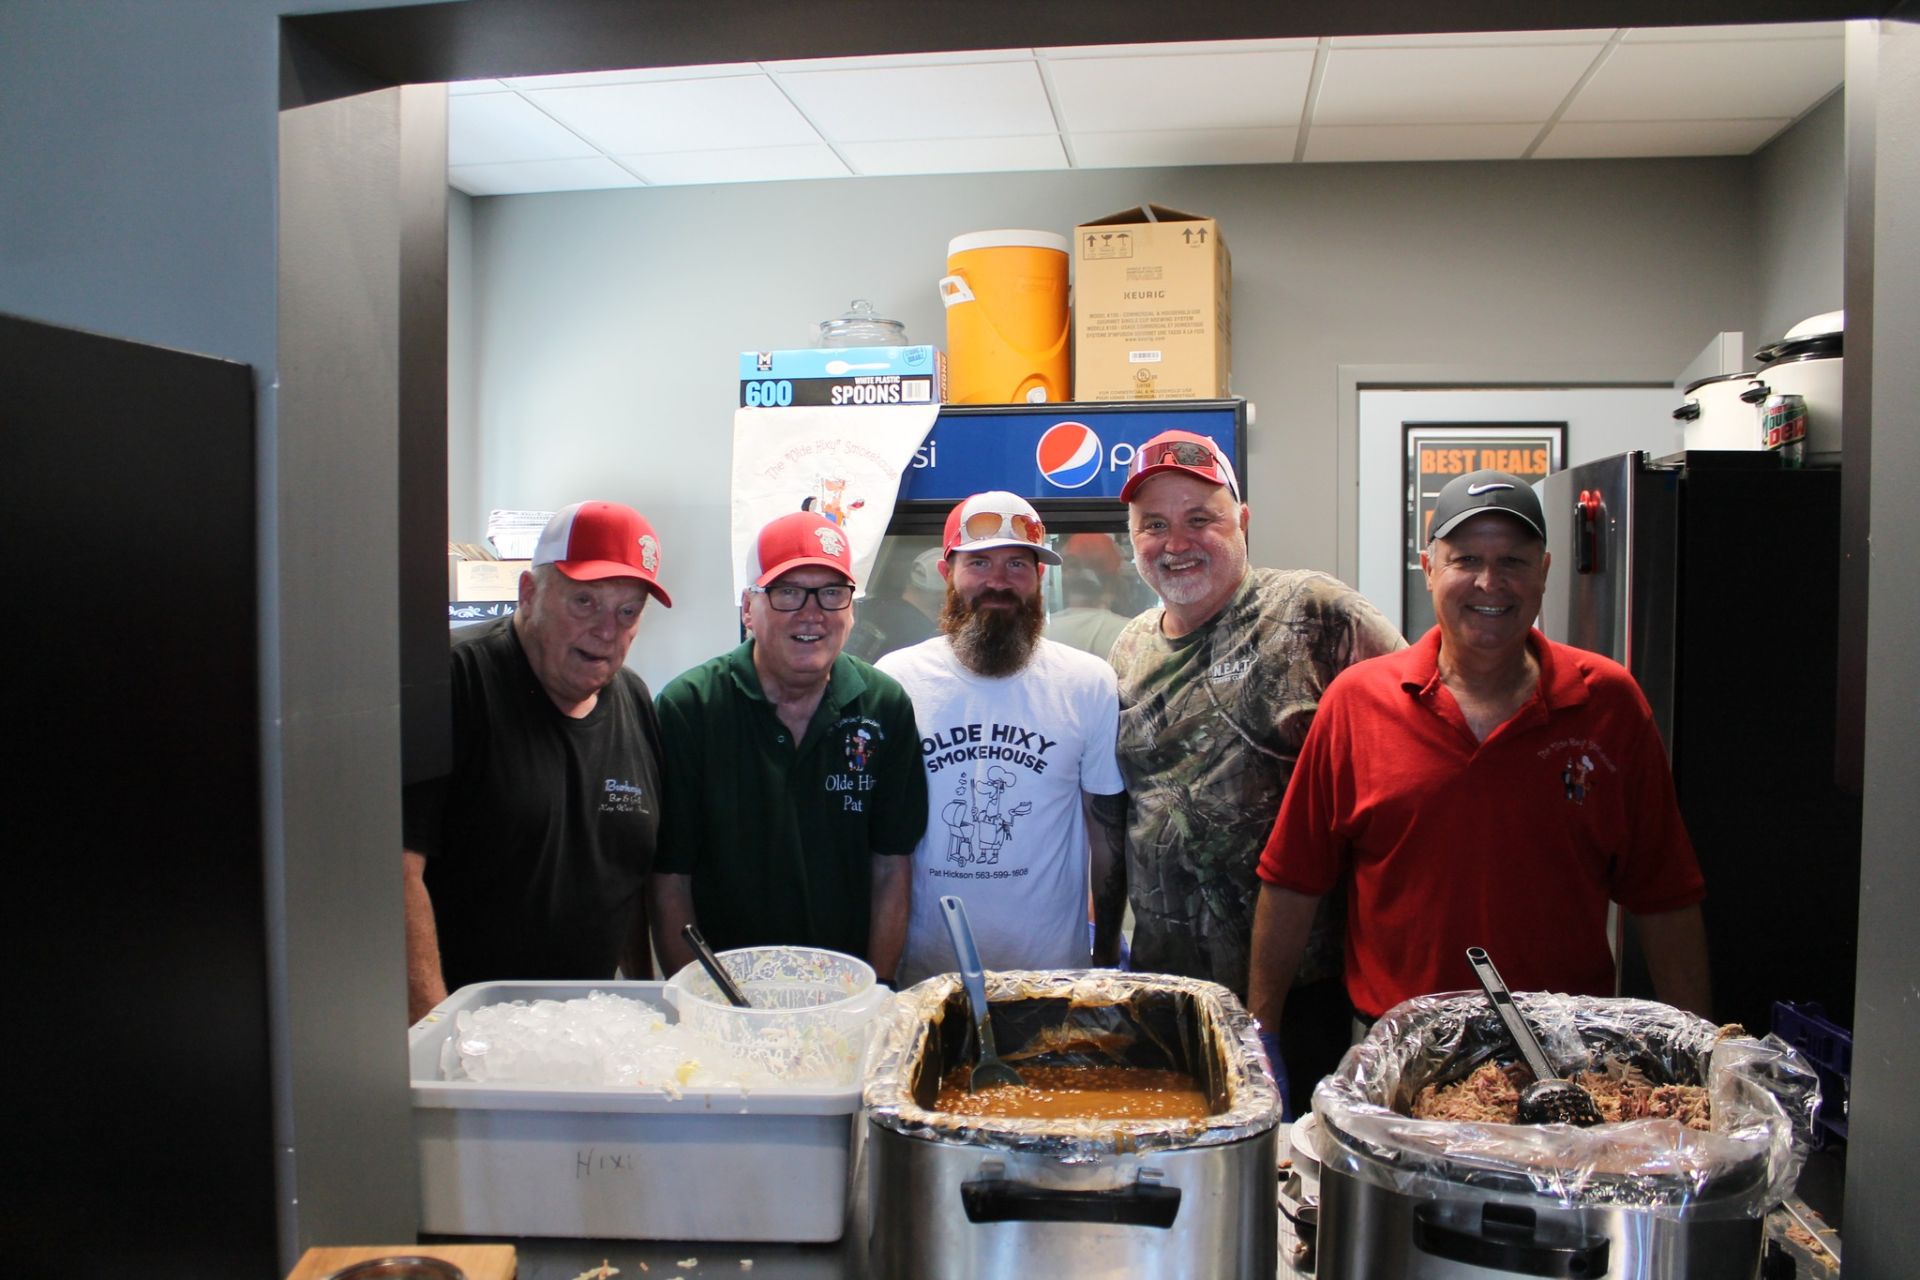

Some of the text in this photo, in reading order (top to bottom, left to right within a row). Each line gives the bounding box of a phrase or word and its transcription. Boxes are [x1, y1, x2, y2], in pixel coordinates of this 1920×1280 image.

[1124, 291, 1165, 300] KEURIG
[854, 376, 901, 384] WHITE PLASTIC
[746, 380, 792, 407] 600
[831, 384, 900, 404] SPOONS
[1421, 449, 1547, 474] BEST DEALS
[920, 724, 982, 756] OLDE
[992, 723, 1057, 755] HIXY
[927, 745, 1048, 774] SMOKEHOUSE
[825, 774, 854, 791] Olde
[843, 795, 863, 812] Pat
[929, 868, 941, 876] Pat
[943, 869, 973, 879] Hickson
